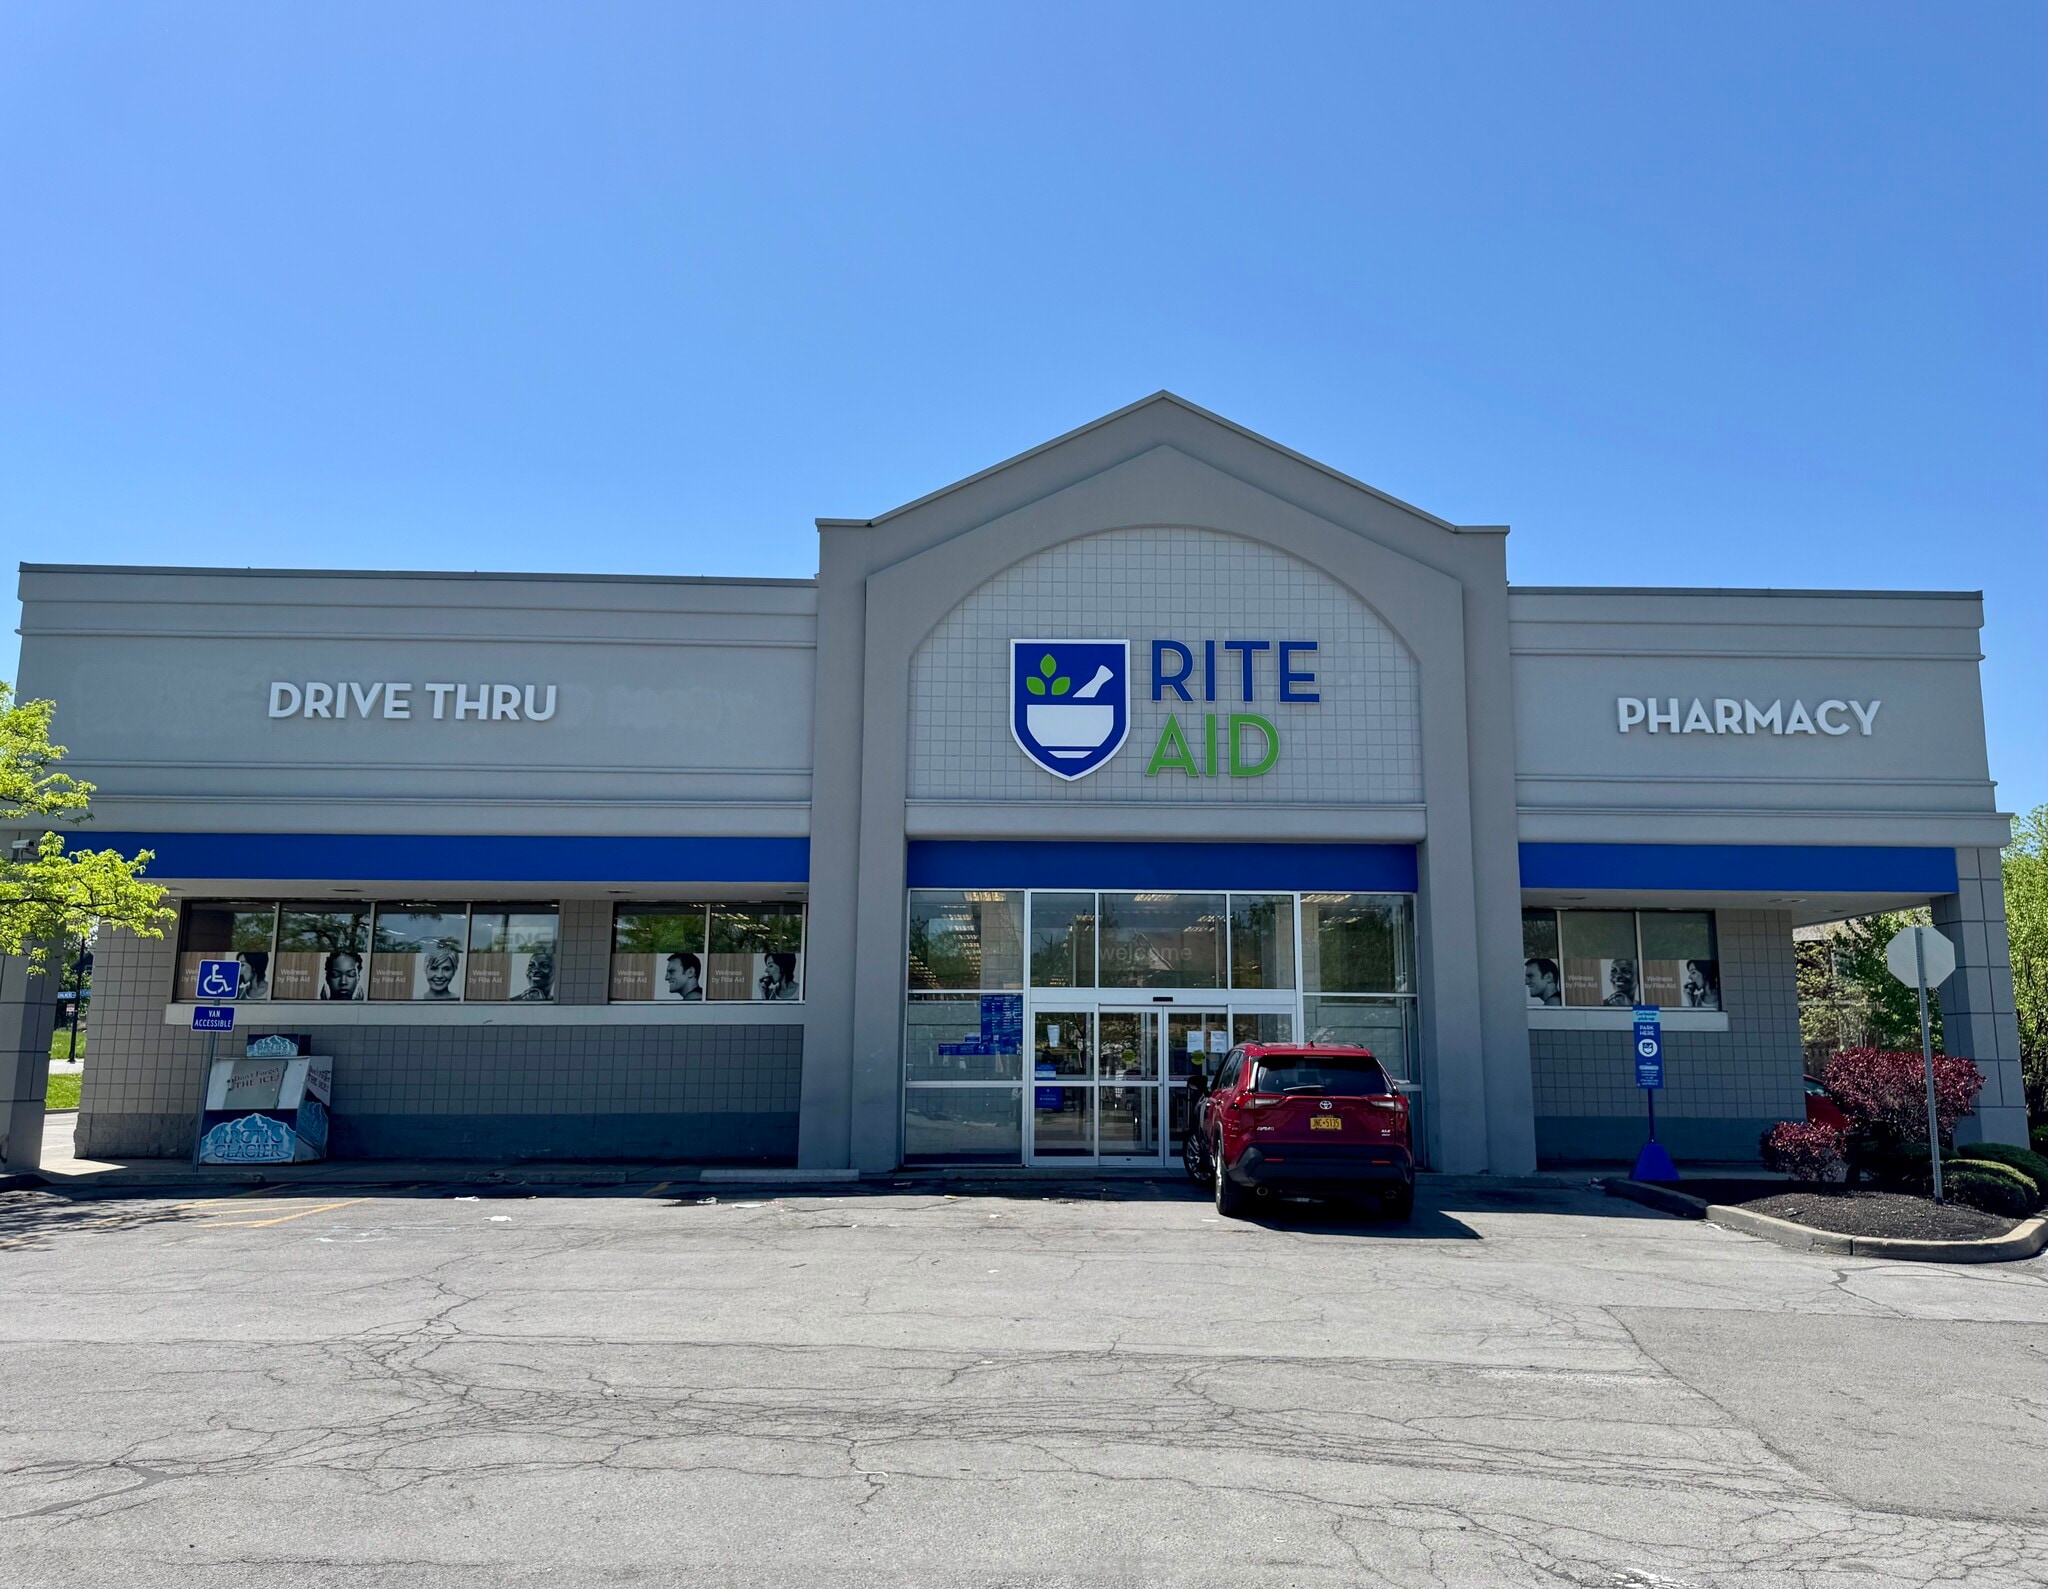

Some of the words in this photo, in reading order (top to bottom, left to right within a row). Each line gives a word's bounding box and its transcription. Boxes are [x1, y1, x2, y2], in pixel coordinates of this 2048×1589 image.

[1151, 639, 1321, 704] RITE
[267, 681, 412, 720] DRIVE
[425, 682, 558, 722] THRU
[1617, 696, 1882, 737] PHARMACY
[1144, 712, 1281, 777] AID
[277, 975, 284, 983] by
[208, 1009, 221, 1018] VAN
[194, 1018, 232, 1028] ACCESSIBLE
[236, 1078, 256, 1089] THE
[214, 1125, 285, 1145] ARCTIC
[214, 1144, 284, 1158] GLACIER
